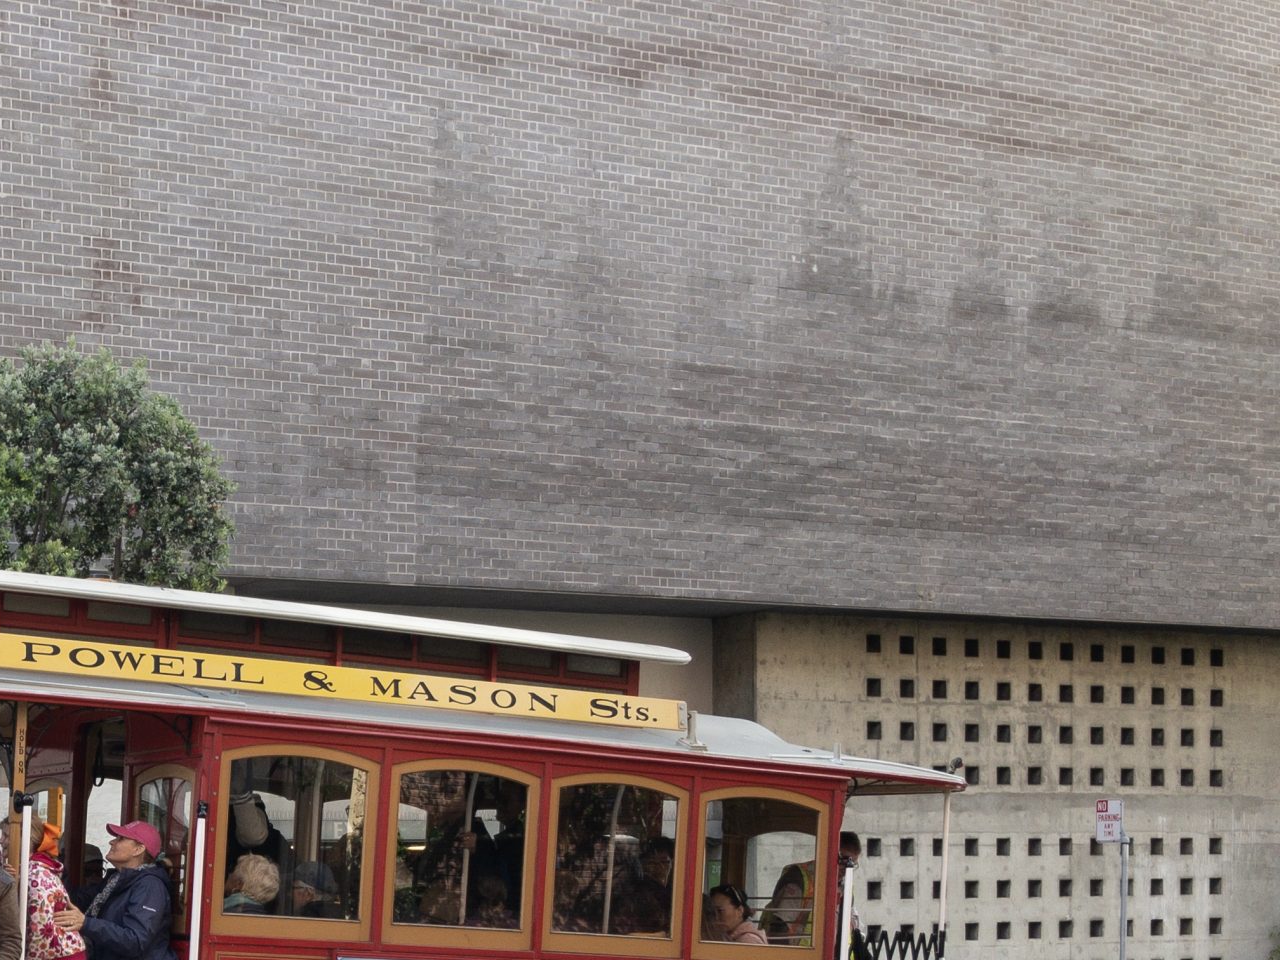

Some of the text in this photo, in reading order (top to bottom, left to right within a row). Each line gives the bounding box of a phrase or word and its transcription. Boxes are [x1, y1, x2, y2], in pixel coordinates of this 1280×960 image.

[22, 641, 659, 722] POWELL & MASON Sts.
[18, 760, 24, 774] ON
[1097, 801, 1107, 811] NO
[1098, 814, 1120, 822] PARKING
